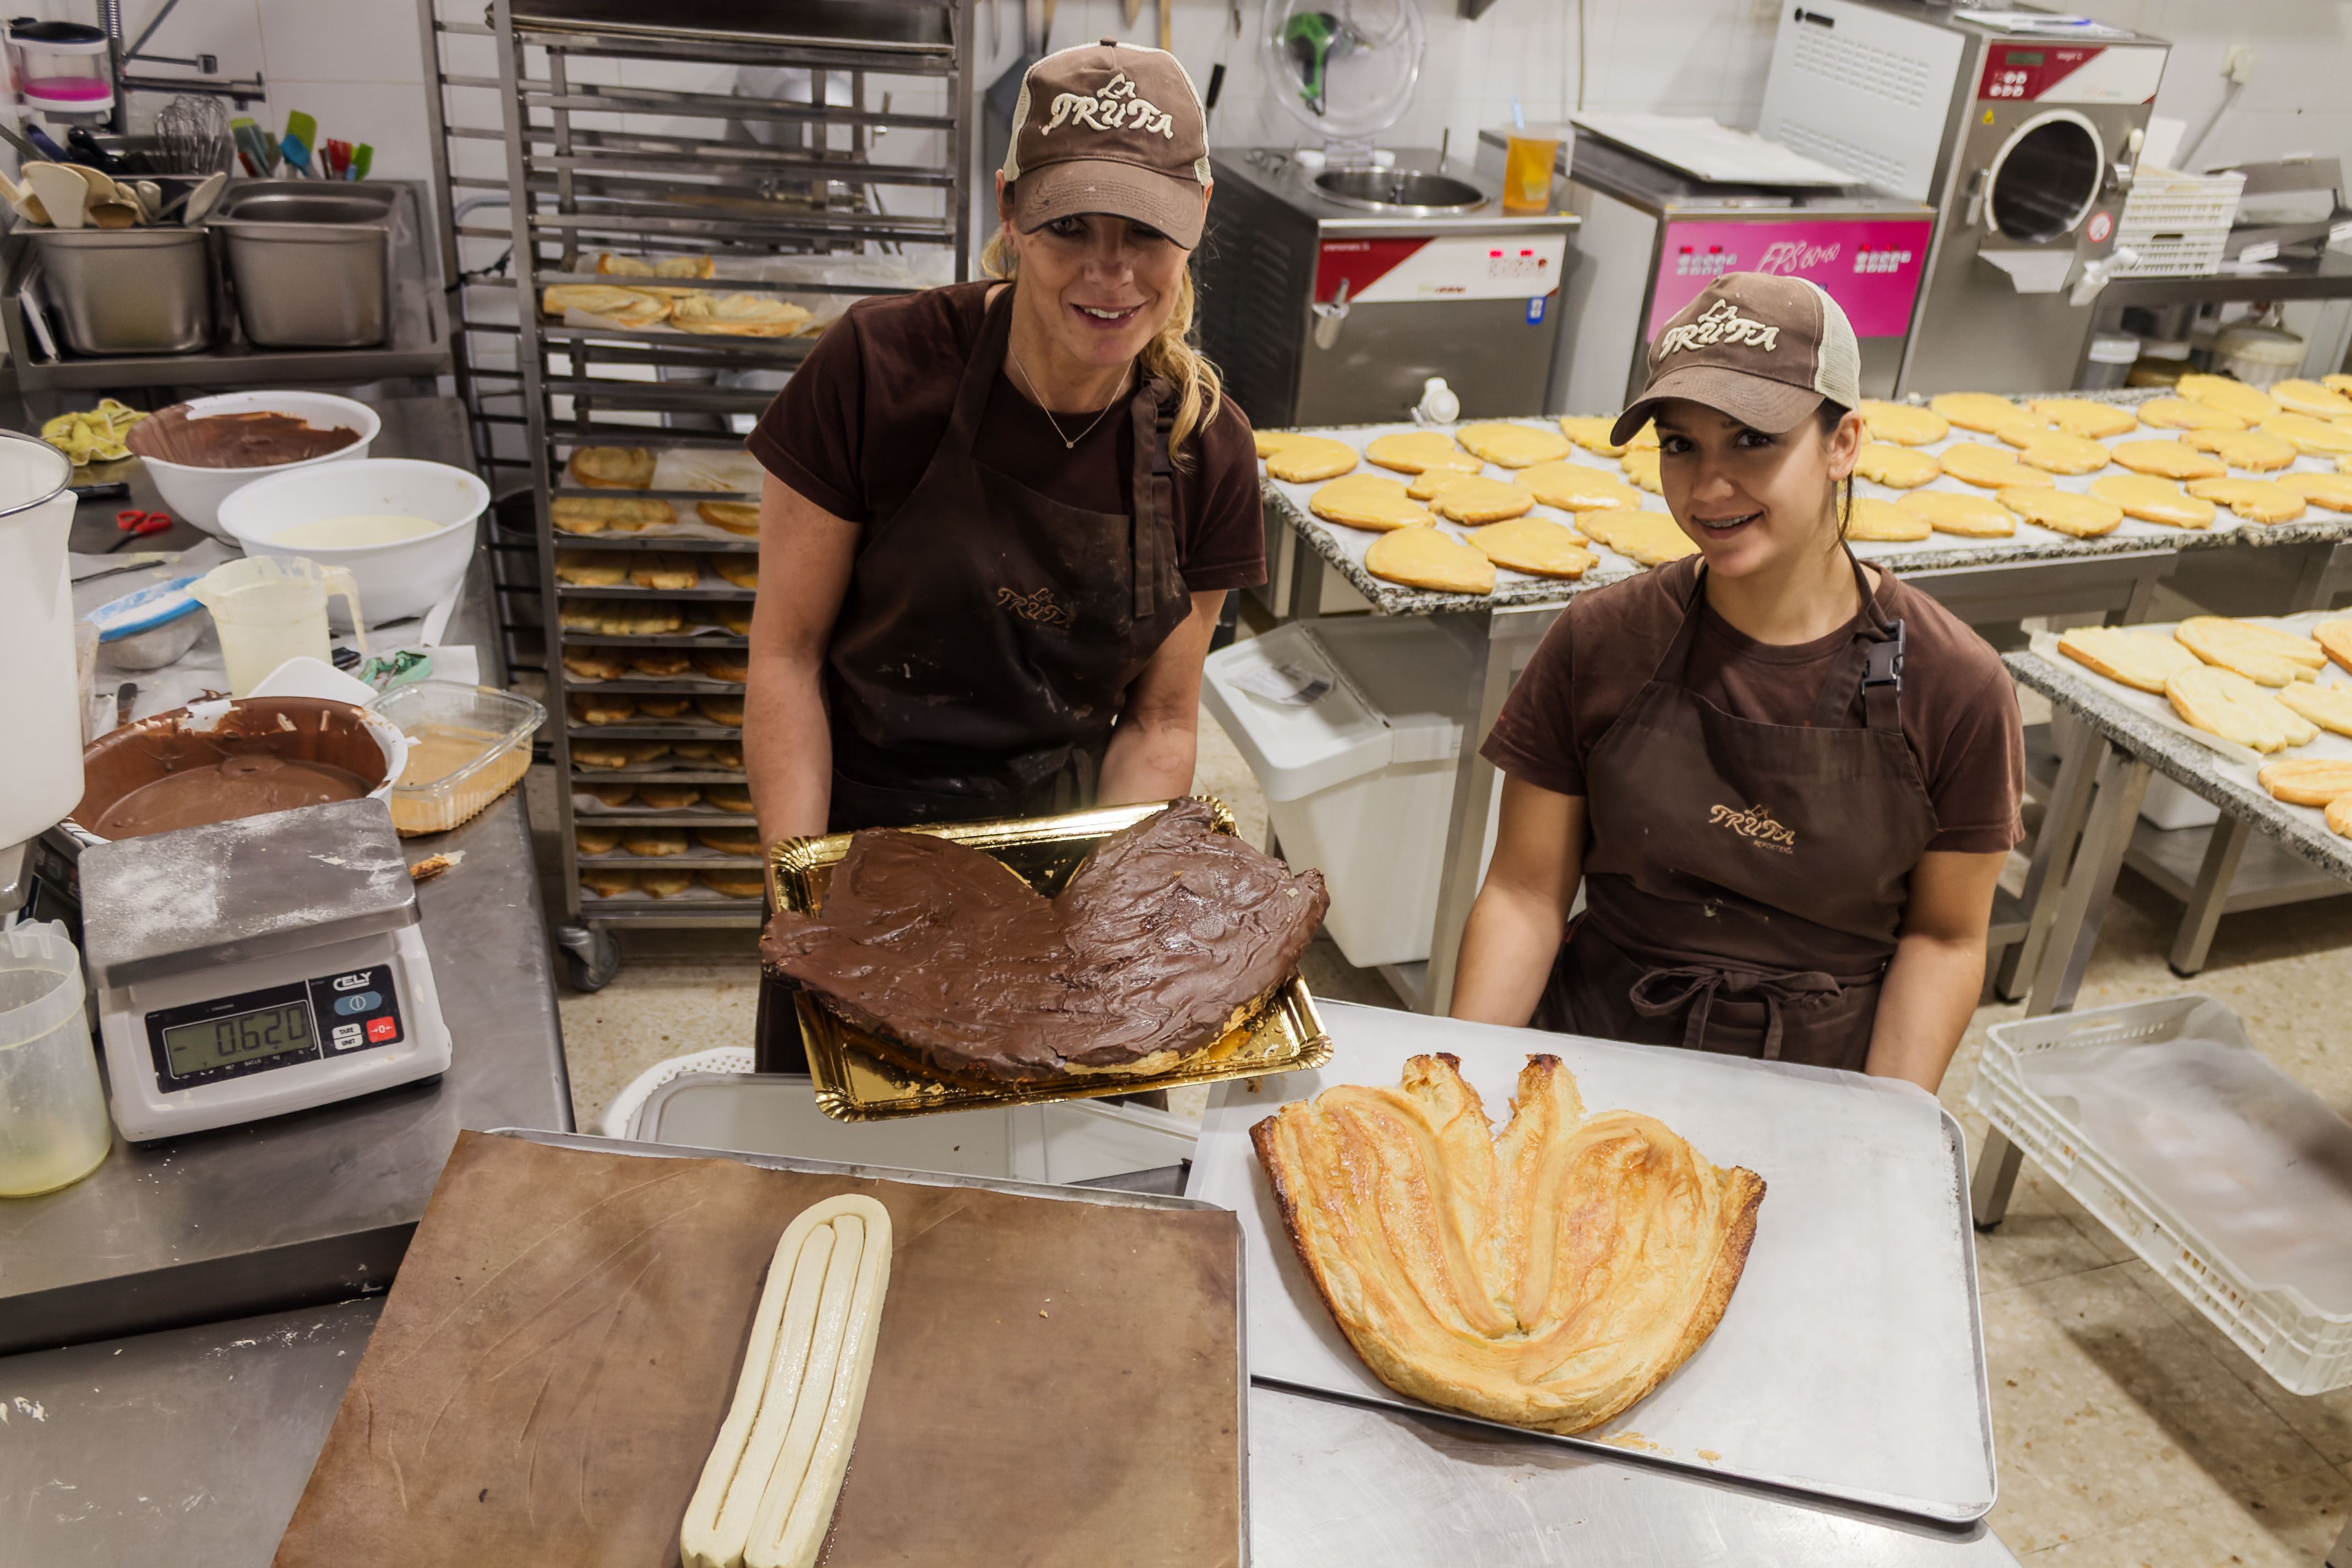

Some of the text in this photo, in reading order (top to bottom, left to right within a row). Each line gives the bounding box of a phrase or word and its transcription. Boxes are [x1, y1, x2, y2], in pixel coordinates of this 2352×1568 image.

[1041, 92, 1174, 139] TRUFA
[1659, 318, 1780, 361] TRUFA
[1709, 804, 1795, 845] TRUFA
[333, 971, 373, 991] CELY
